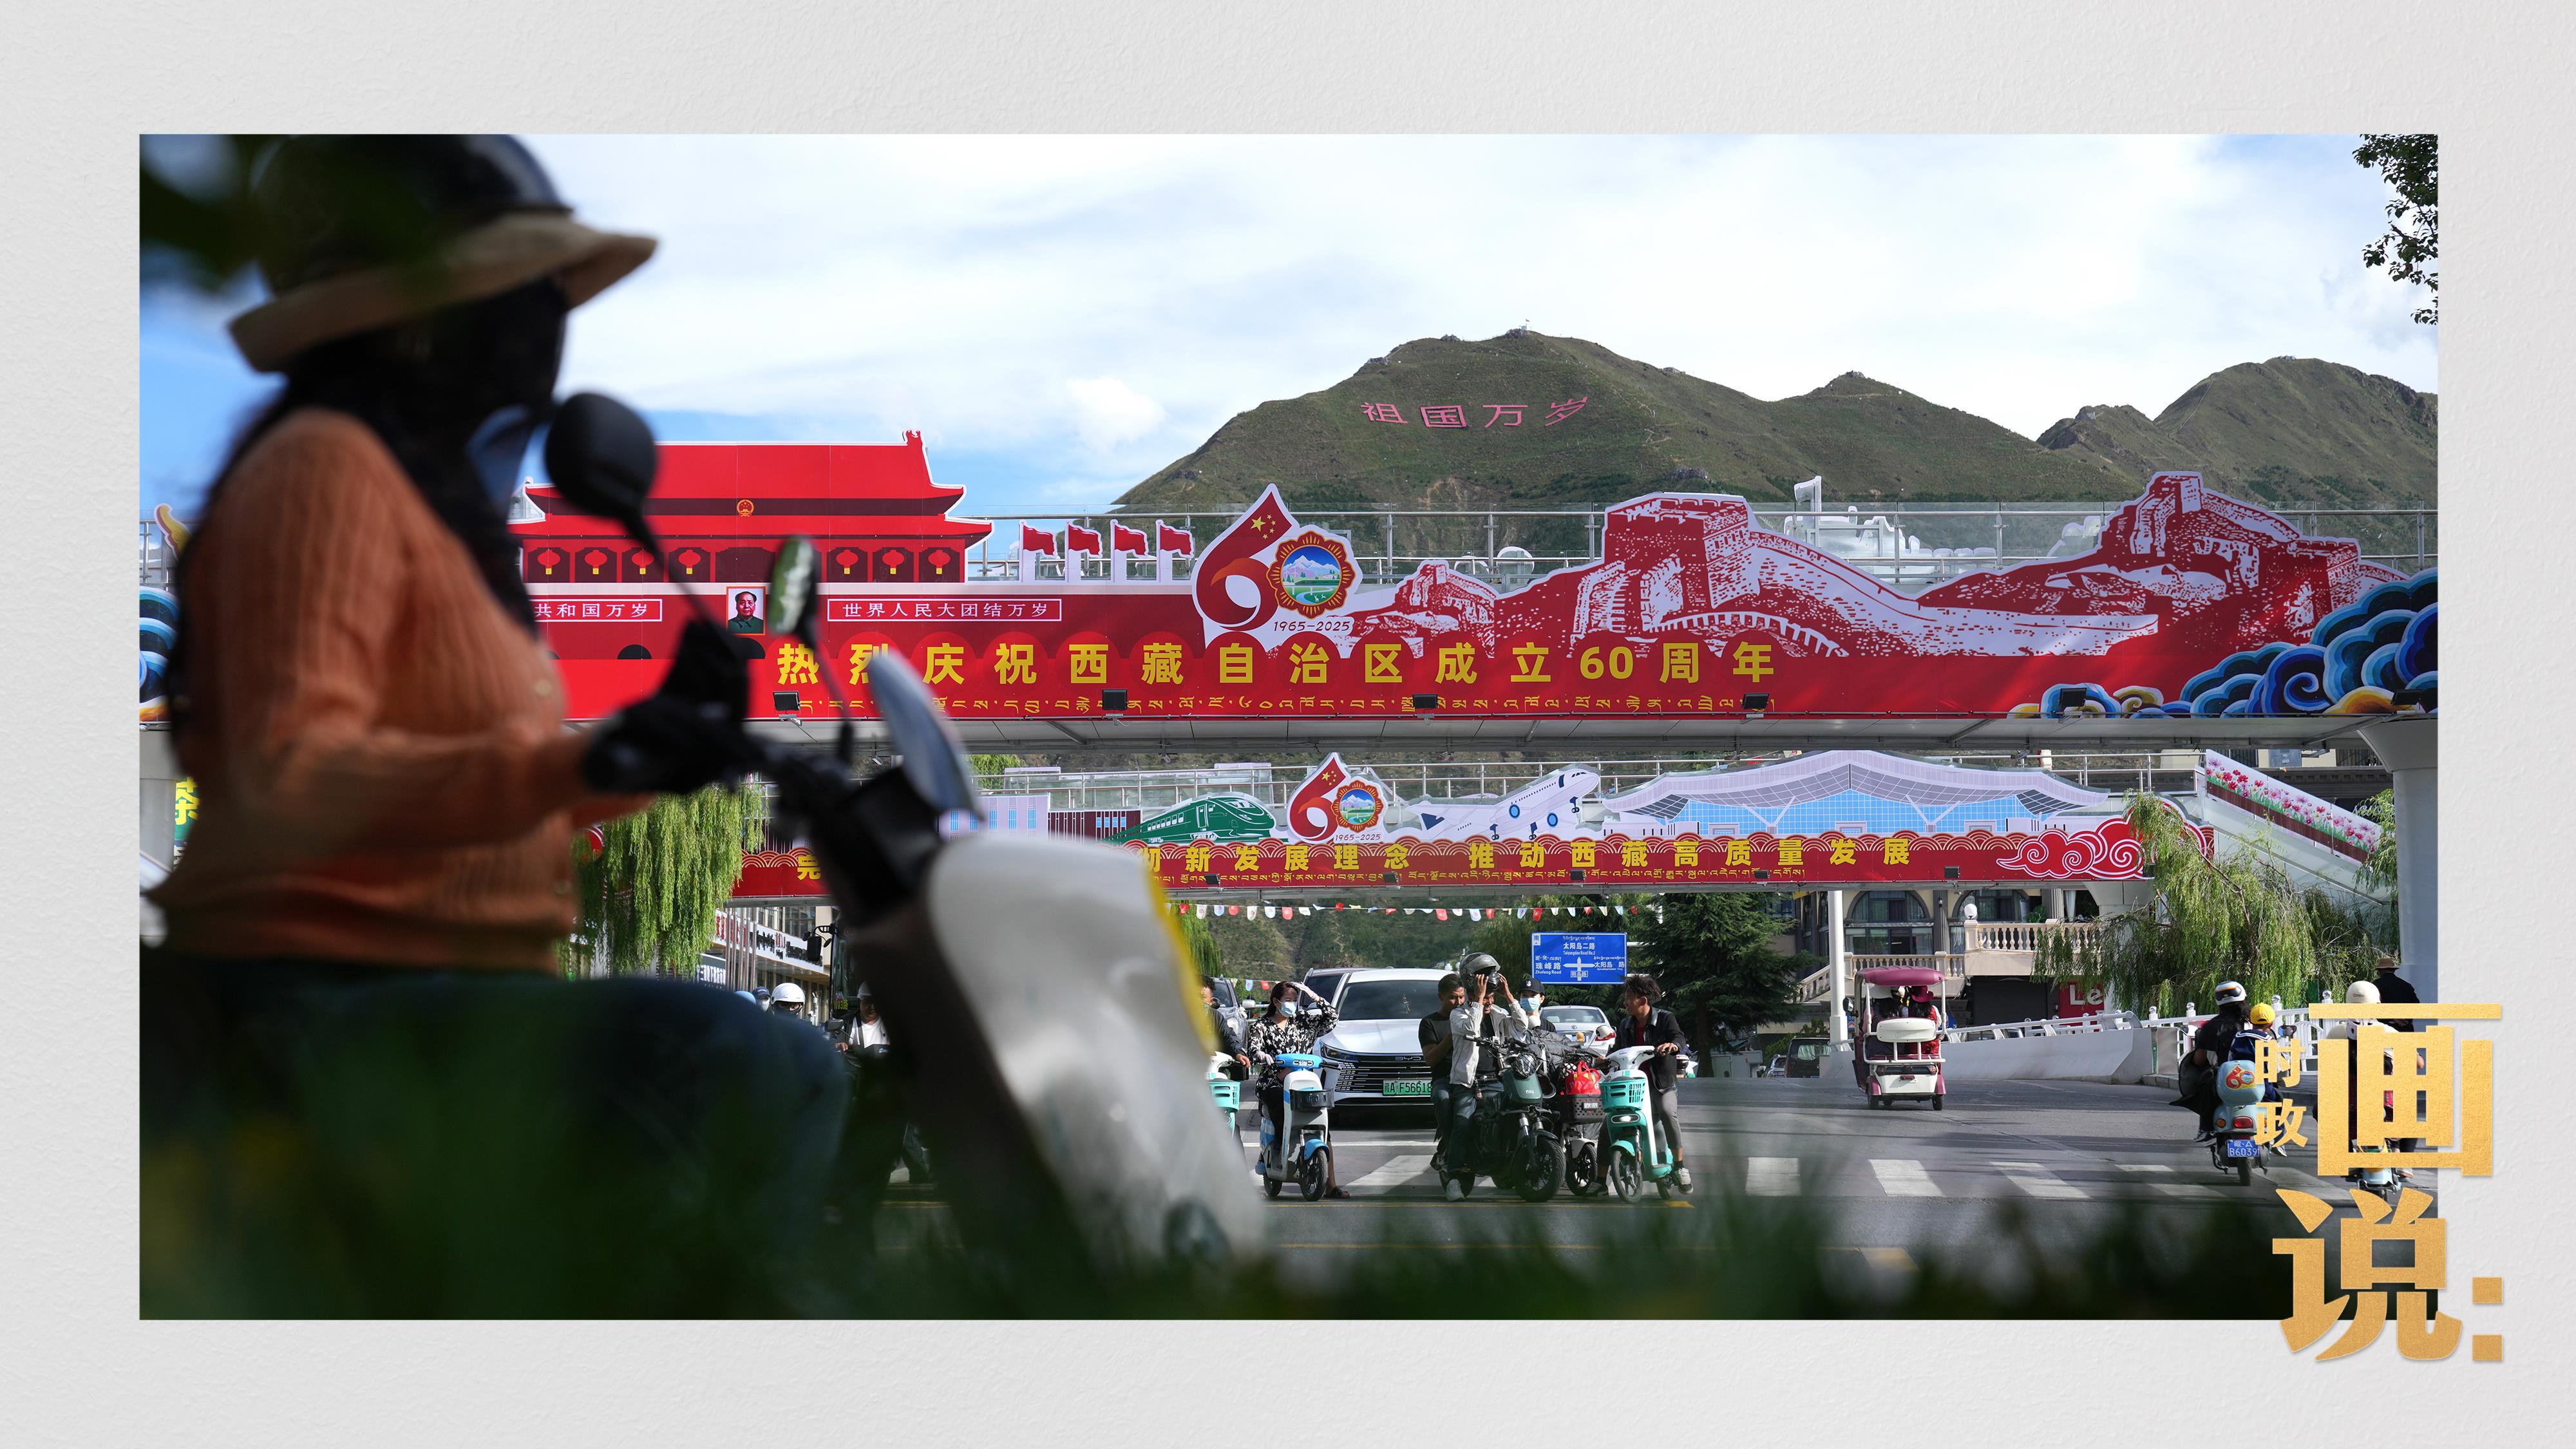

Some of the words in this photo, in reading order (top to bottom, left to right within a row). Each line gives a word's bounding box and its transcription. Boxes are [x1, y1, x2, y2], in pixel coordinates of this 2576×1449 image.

[1360, 396, 1587, 428] 祖国万岁
[535, 603, 647, 618] 共和国万岁
[842, 603, 1048, 618] 世界人民大团结万岁
[1274, 621, 1350, 632] 1965-2025
[777, 642, 1774, 685] 热烈庆祝西藏自治区成立60周年
[1469, 838, 1910, 869] 推动西藏高质量发展
